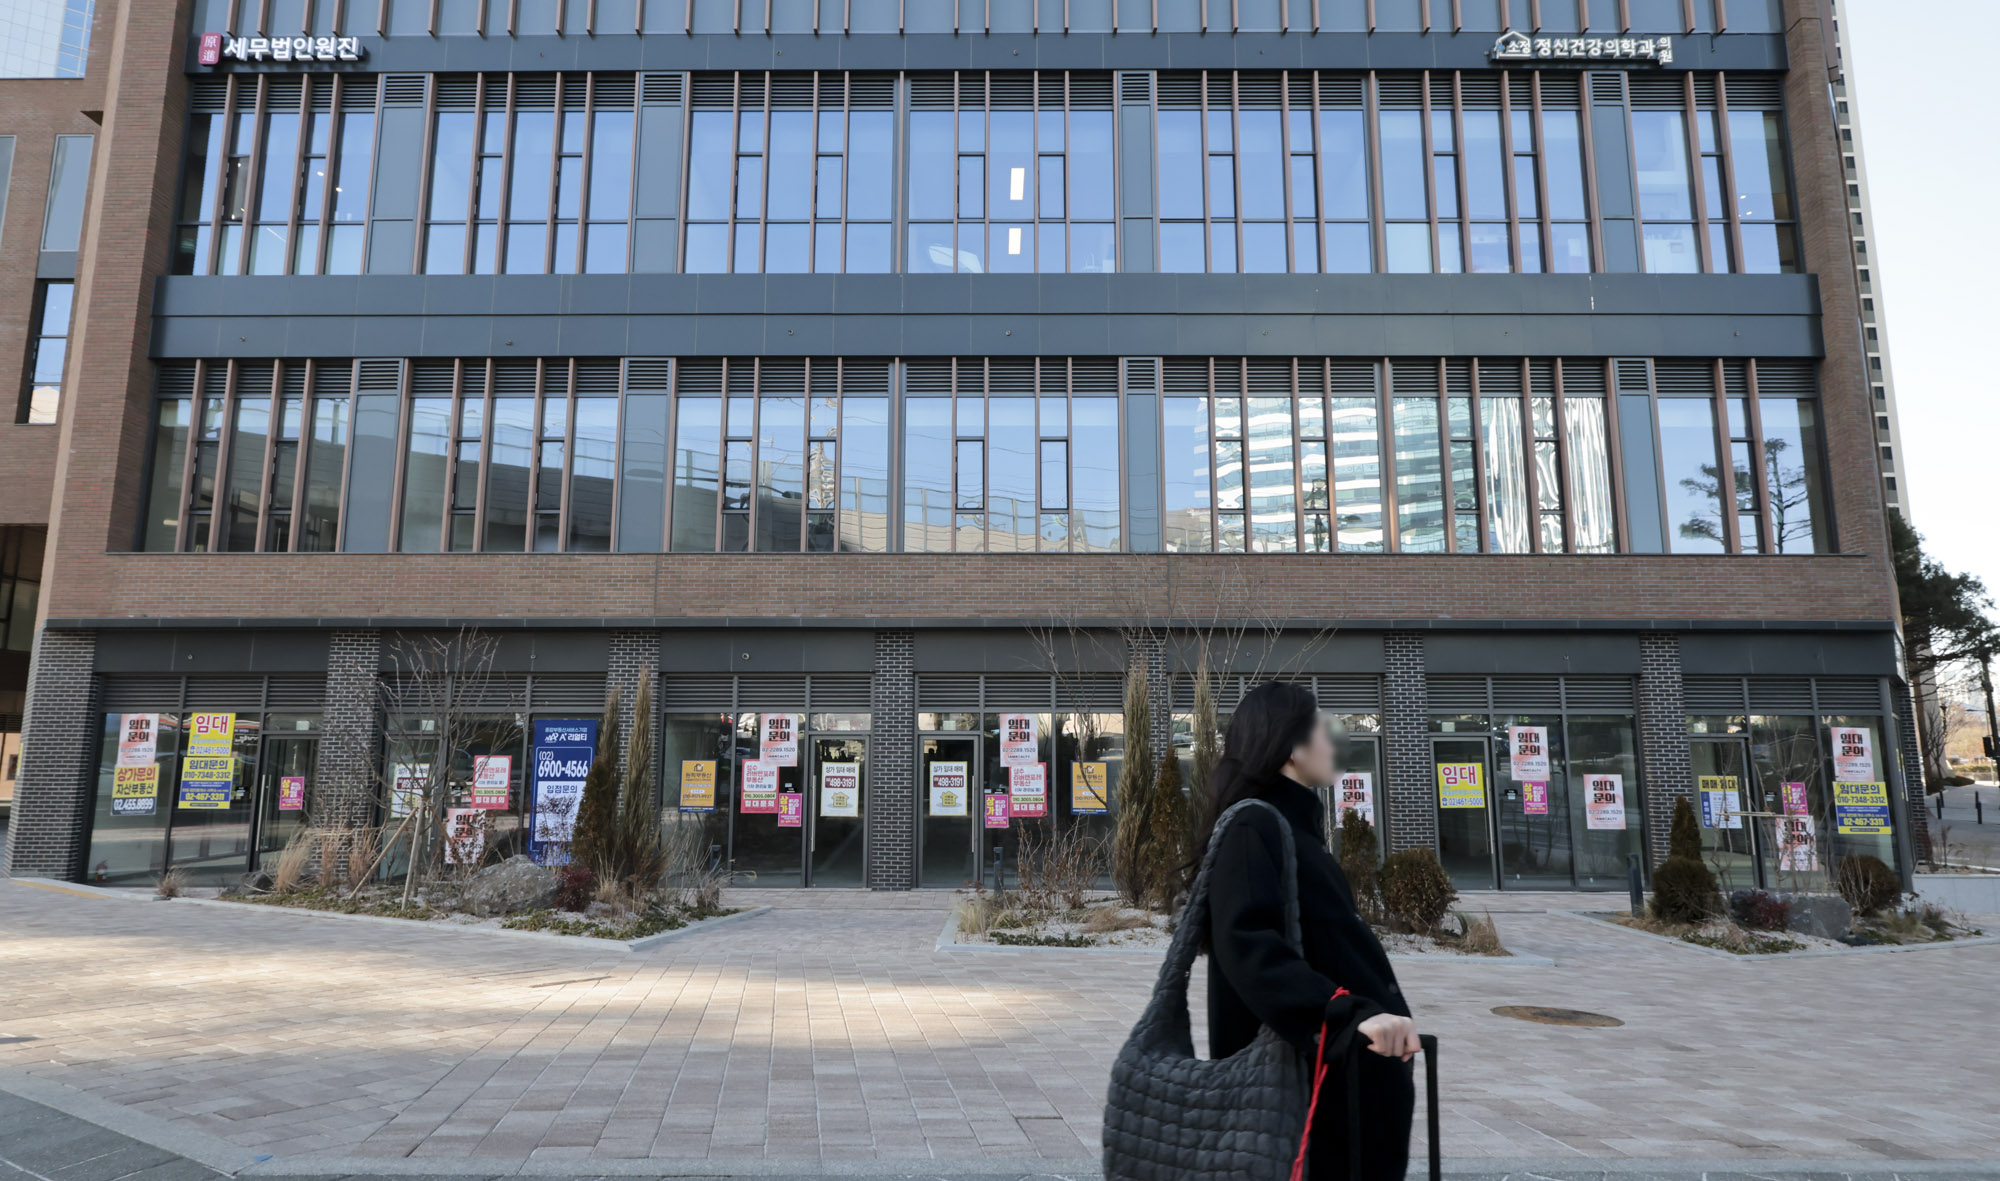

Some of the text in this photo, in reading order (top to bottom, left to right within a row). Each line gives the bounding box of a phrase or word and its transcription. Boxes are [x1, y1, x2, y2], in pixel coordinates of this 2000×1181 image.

[224, 36, 359, 61] 세무법인원진
[1535, 37, 1655, 58] 정신건강의학과
[129, 719, 150, 730] 임대
[196, 714, 229, 734] 임대
[769, 719, 790, 730] 임대
[1008, 719, 1030, 730] 임대
[128, 732, 149, 742] 문의
[768, 731, 790, 742] 문의
[1008, 731, 1030, 742] 문의
[1518, 732, 1540, 743] 임대
[1841, 734, 1863, 744] 임대
[539, 751, 554, 760] (02)
[1518, 745, 1540, 755] 문의
[1842, 746, 1864, 757] 문의
[190, 760, 228, 770] 임대문의
[538, 760, 588, 778] 6900-4566
[118, 768, 156, 782] 상가문의
[1442, 766, 1476, 784] 임대
[116, 783, 154, 794] 자산부동산
[547, 785, 578, 794] 입점문의
[1342, 779, 1364, 789] 임대
[1592, 780, 1615, 791] 임대
[1840, 784, 1880, 794] 임대문의
[1343, 792, 1365, 802] 문의
[1594, 793, 1616, 804] 문의
